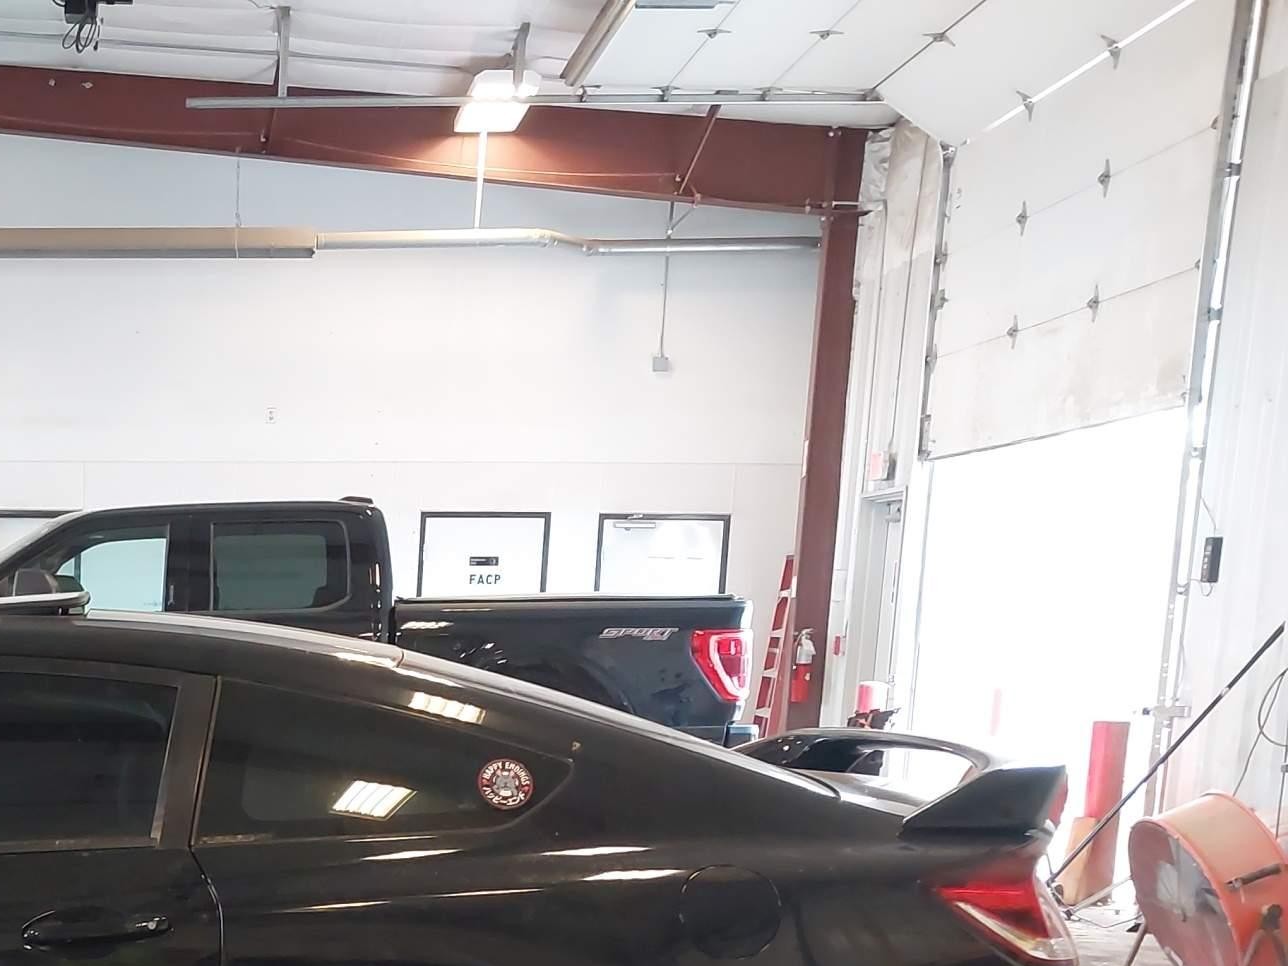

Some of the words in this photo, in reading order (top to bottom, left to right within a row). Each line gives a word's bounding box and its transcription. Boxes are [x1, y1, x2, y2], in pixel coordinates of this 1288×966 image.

[469, 574, 501, 585] FACP
[599, 627, 679, 640] SPORT
[482, 762, 503, 779] HAPPY
[505, 762, 530, 785] ENDINGS
